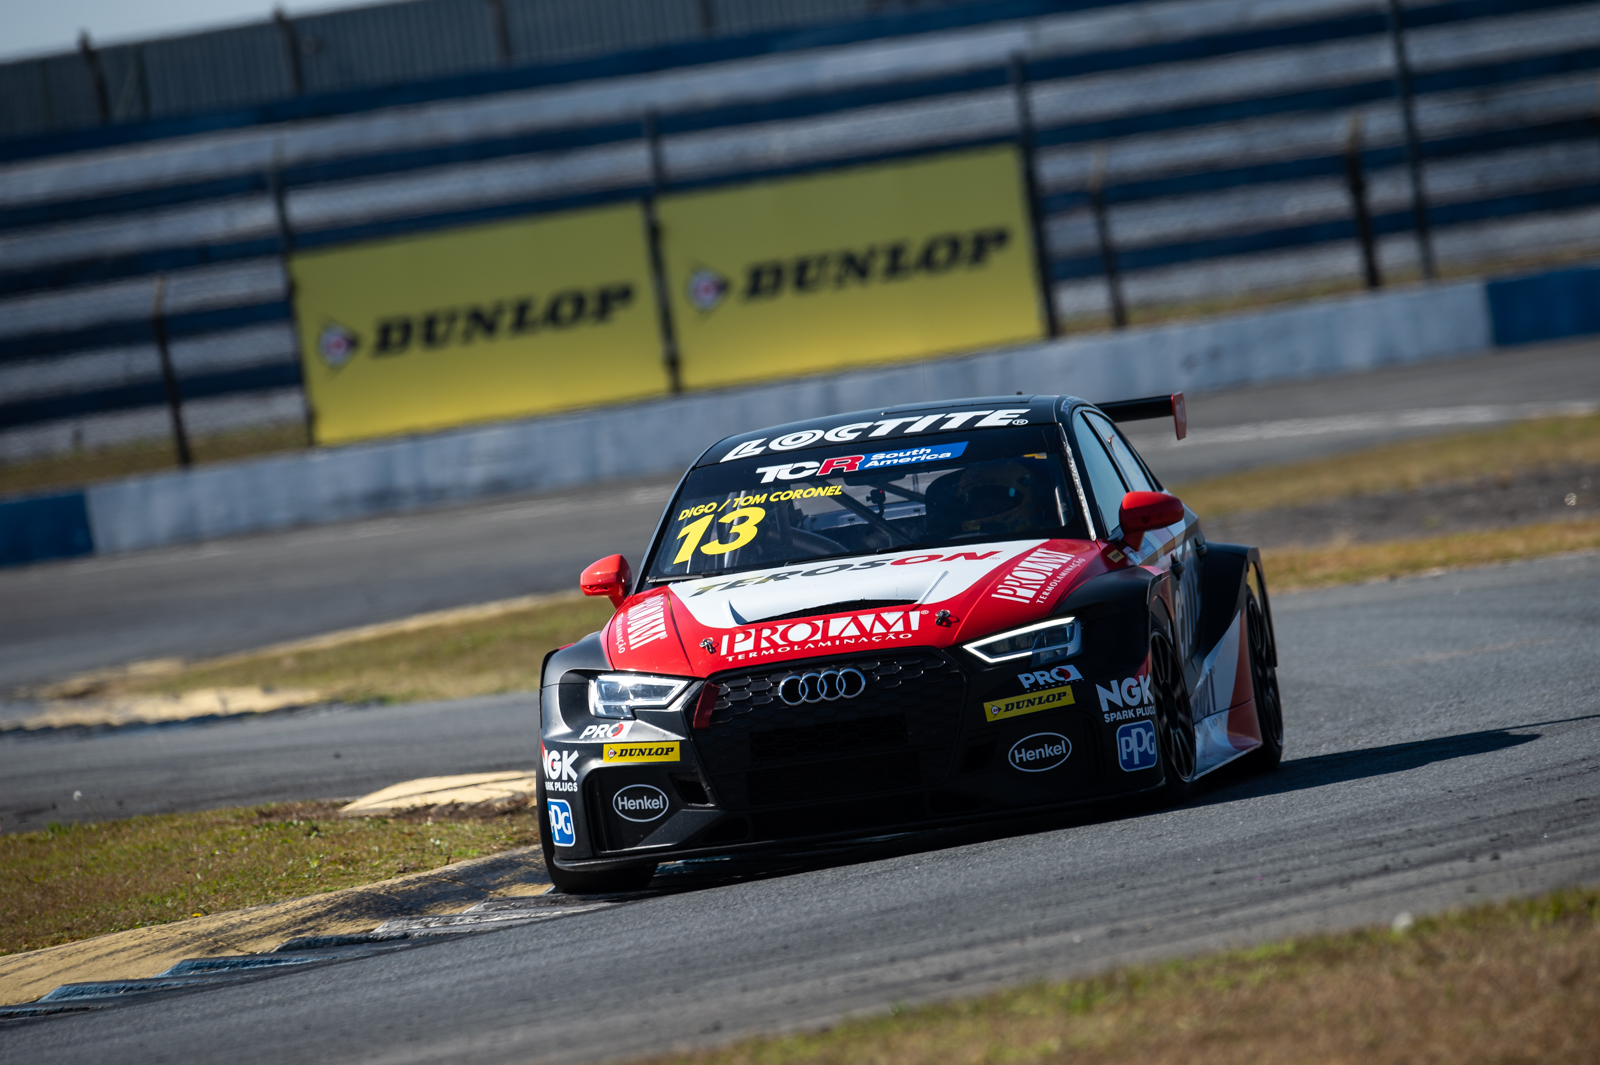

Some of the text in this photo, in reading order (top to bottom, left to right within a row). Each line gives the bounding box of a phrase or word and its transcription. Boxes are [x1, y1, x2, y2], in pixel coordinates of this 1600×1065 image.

[741, 227, 1012, 300] DUNLOP
[372, 283, 636, 357] DUNLOP
[720, 408, 1031, 463] LOCTITE
[756, 454, 866, 484] TCR
[863, 451, 952, 469] America
[870, 448, 931, 461] South
[678, 502, 718, 521] DIGO
[732, 492, 769, 509] TOM
[769, 485, 843, 503] CORONEL
[672, 506, 766, 565] 13
[689, 551, 1002, 597] TEROSON
[1036, 557, 1086, 604] TERMOLAMINAÇÃO
[726, 633, 913, 661] TERMOLAMINAÇÃO
[1004, 691, 1067, 712] DUNLOP
[1095, 673, 1154, 713] NGK
[1104, 705, 1156, 724] SPARK PLUGS
[618, 747, 675, 757] DUNLOP
[1014, 741, 1067, 764] Henkel
[1120, 727, 1156, 765] PPG
[554, 781, 578, 792] PLUGS
[618, 795, 664, 810] Henkel
